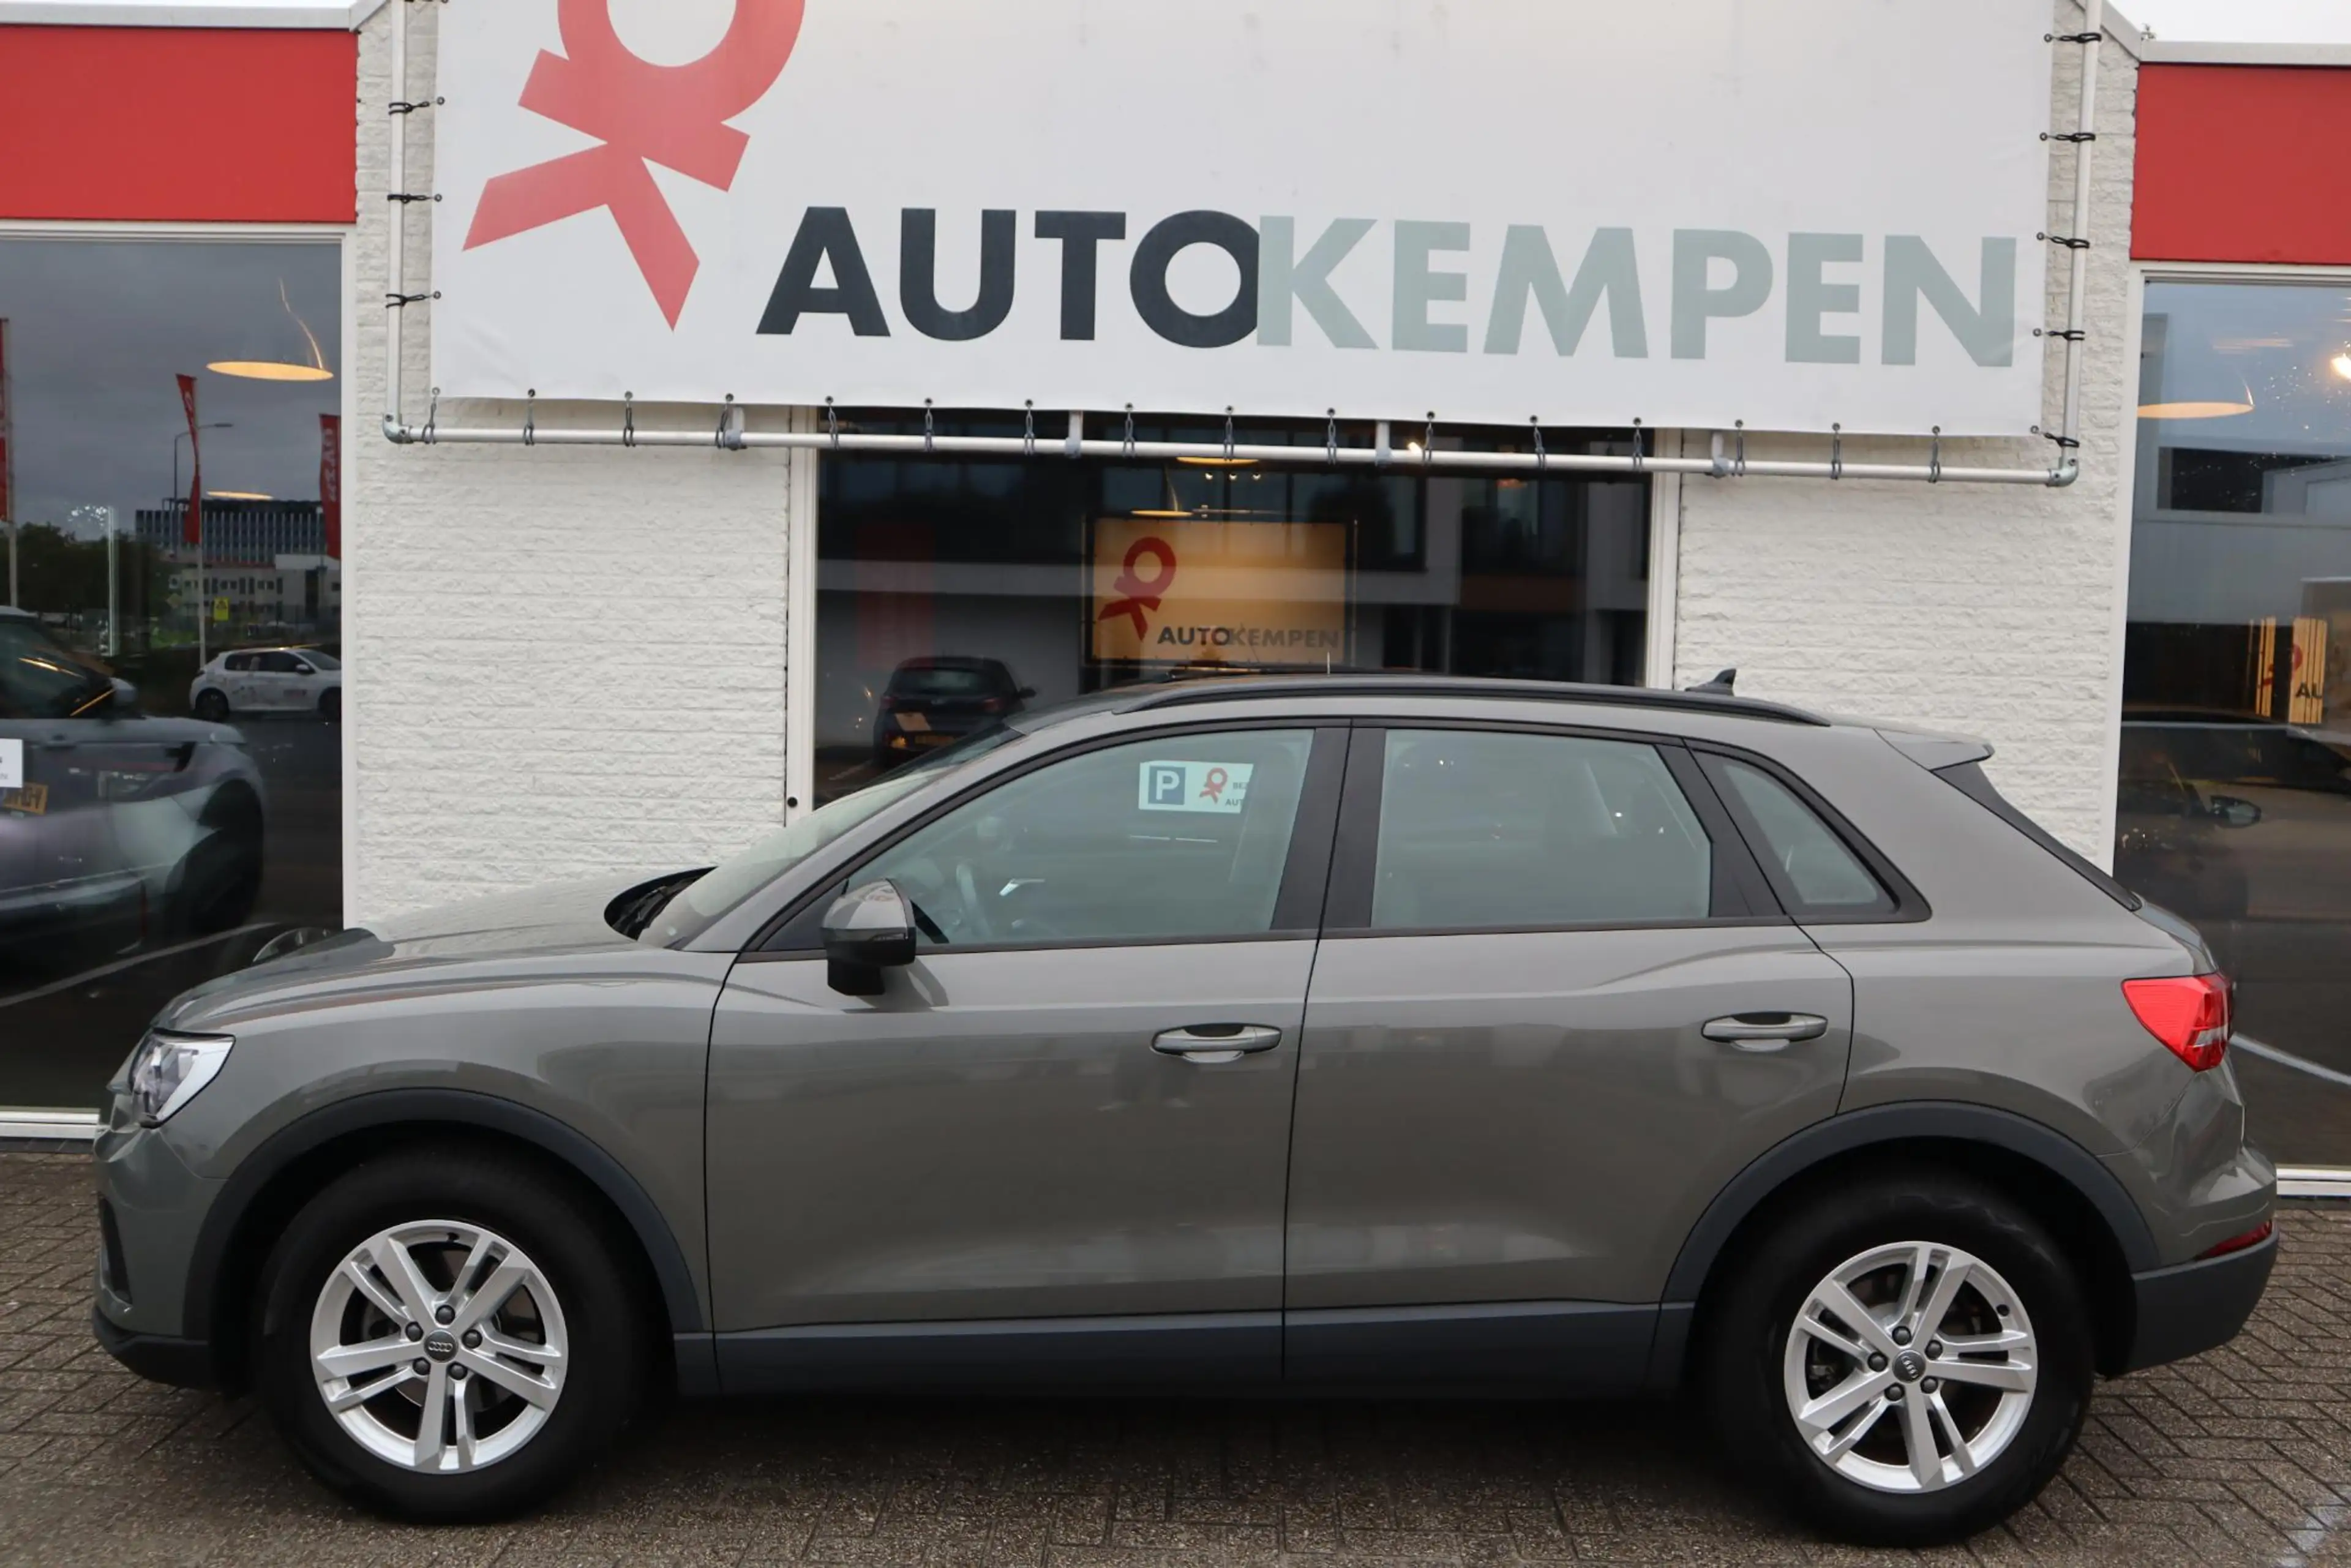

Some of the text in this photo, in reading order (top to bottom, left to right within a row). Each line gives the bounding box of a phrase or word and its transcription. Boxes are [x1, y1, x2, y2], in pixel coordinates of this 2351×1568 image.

[756, 206, 2017, 367] AUTOKEMPEN
[1157, 625, 1340, 649] AUTOKEMPEN
[1156, 770, 1180, 800] P
